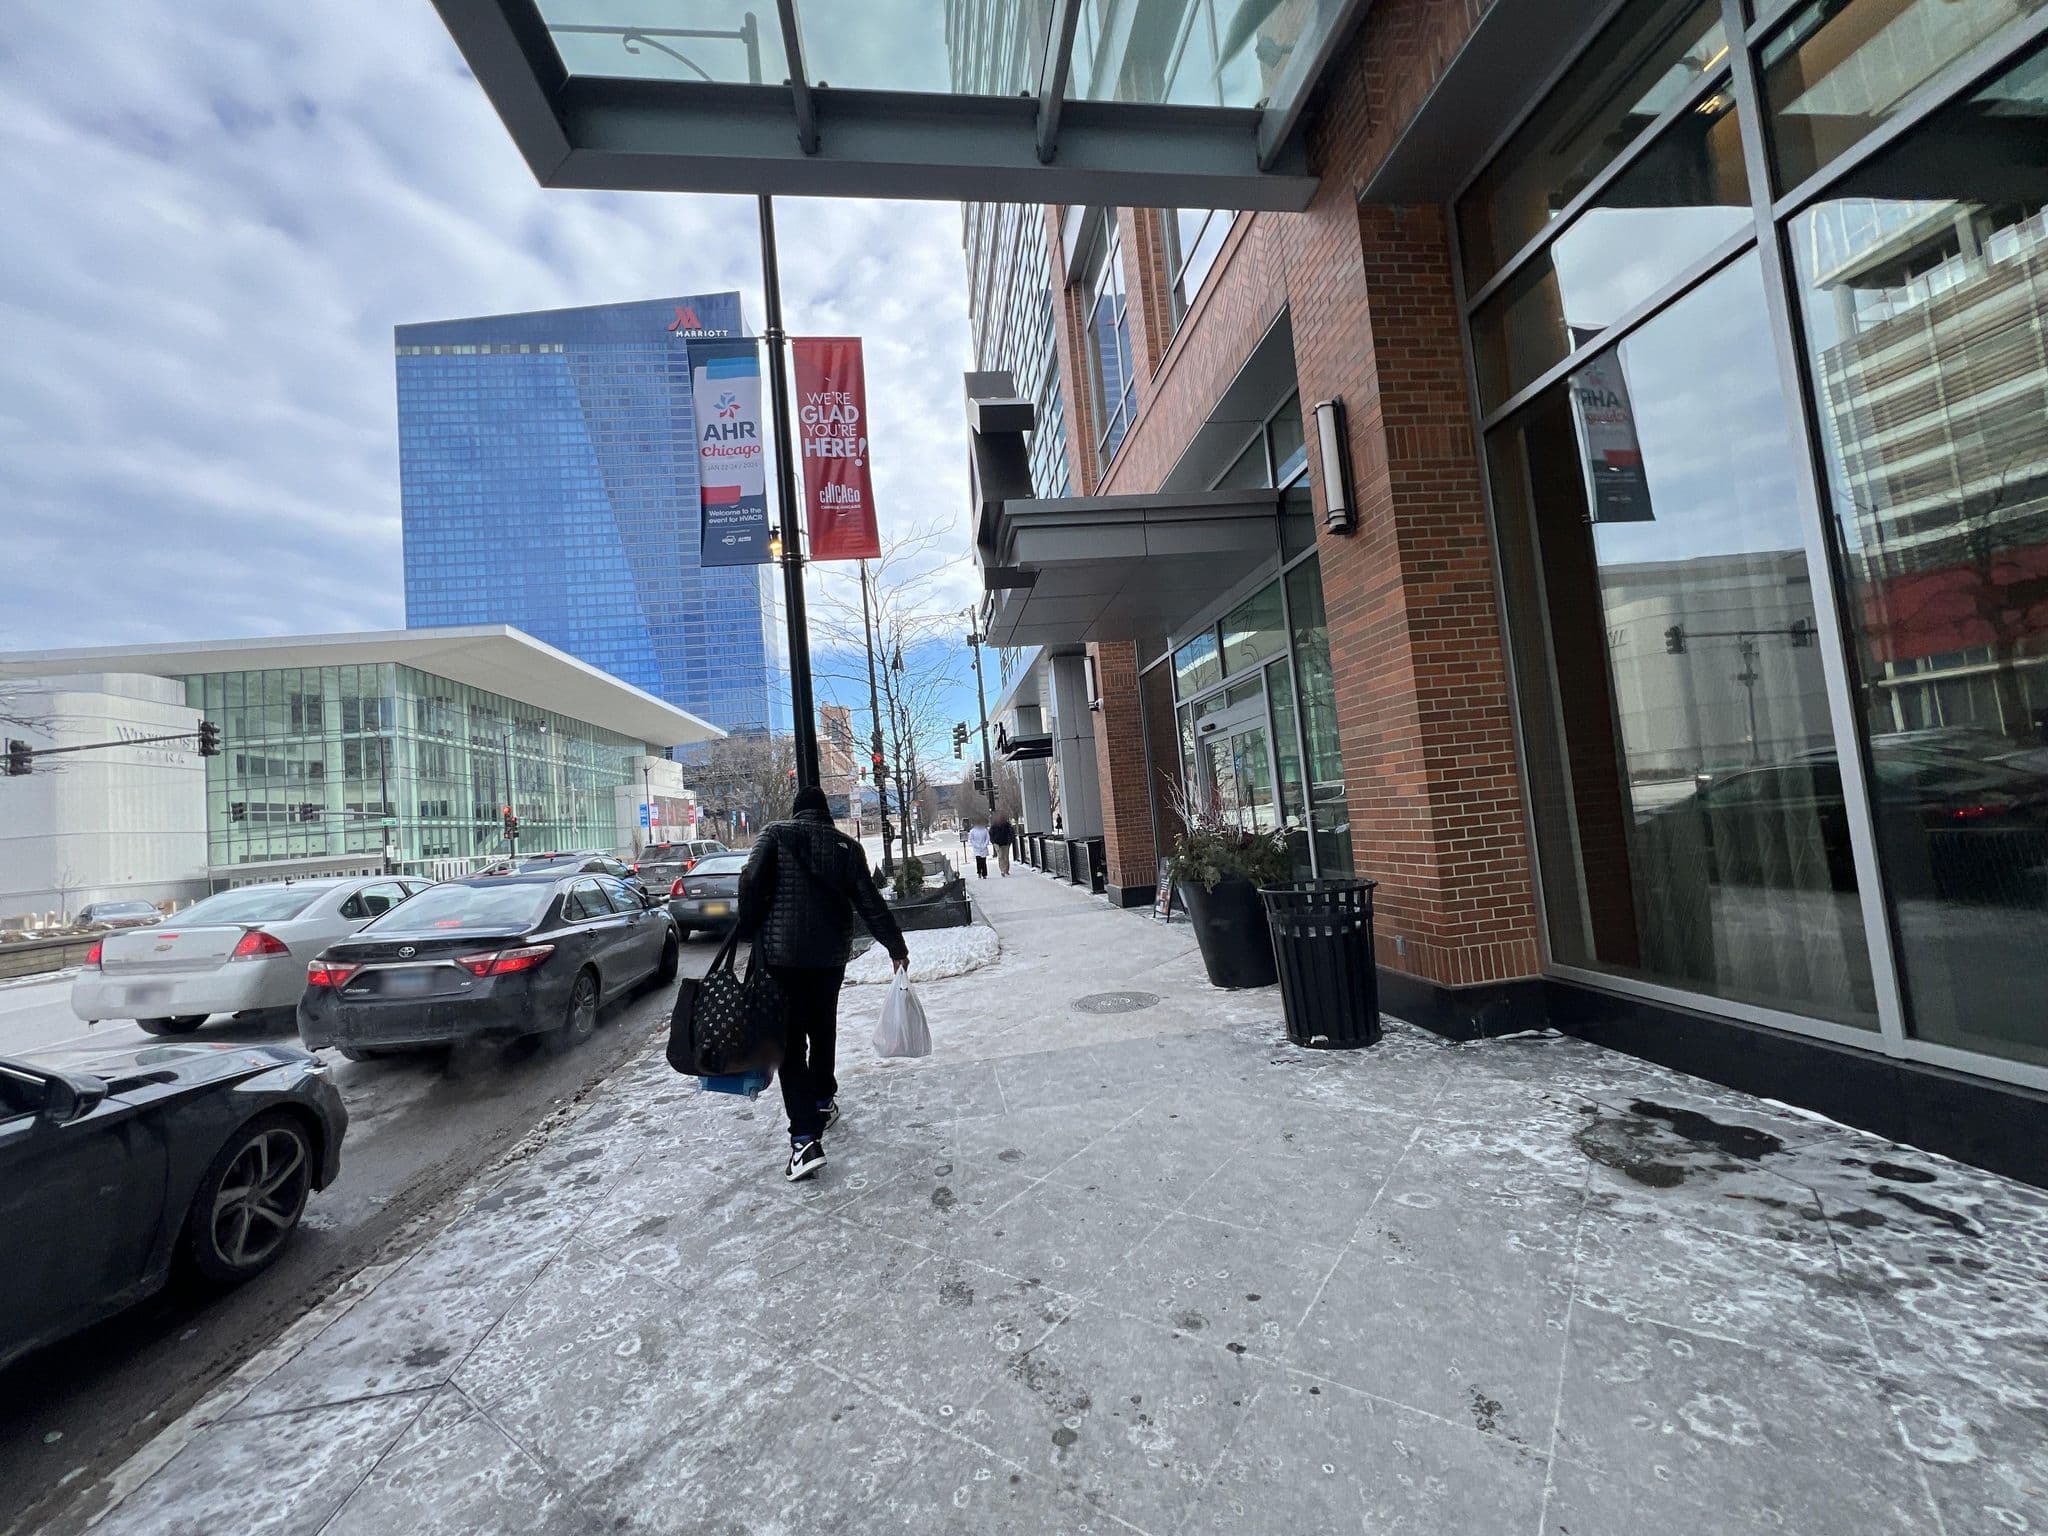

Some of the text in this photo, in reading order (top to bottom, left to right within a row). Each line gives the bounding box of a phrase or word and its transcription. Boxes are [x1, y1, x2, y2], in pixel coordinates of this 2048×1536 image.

[676, 329, 728, 338] MARRIOTT
[807, 391, 851, 405] WE'RE
[801, 405, 859, 424] GLAD
[703, 421, 757, 441] AHR
[806, 424, 857, 437] YOU'RE
[804, 437, 867, 467] HERE!
[709, 509, 741, 517] Welcome
[709, 516, 727, 524] event
[729, 515, 738, 523] for
